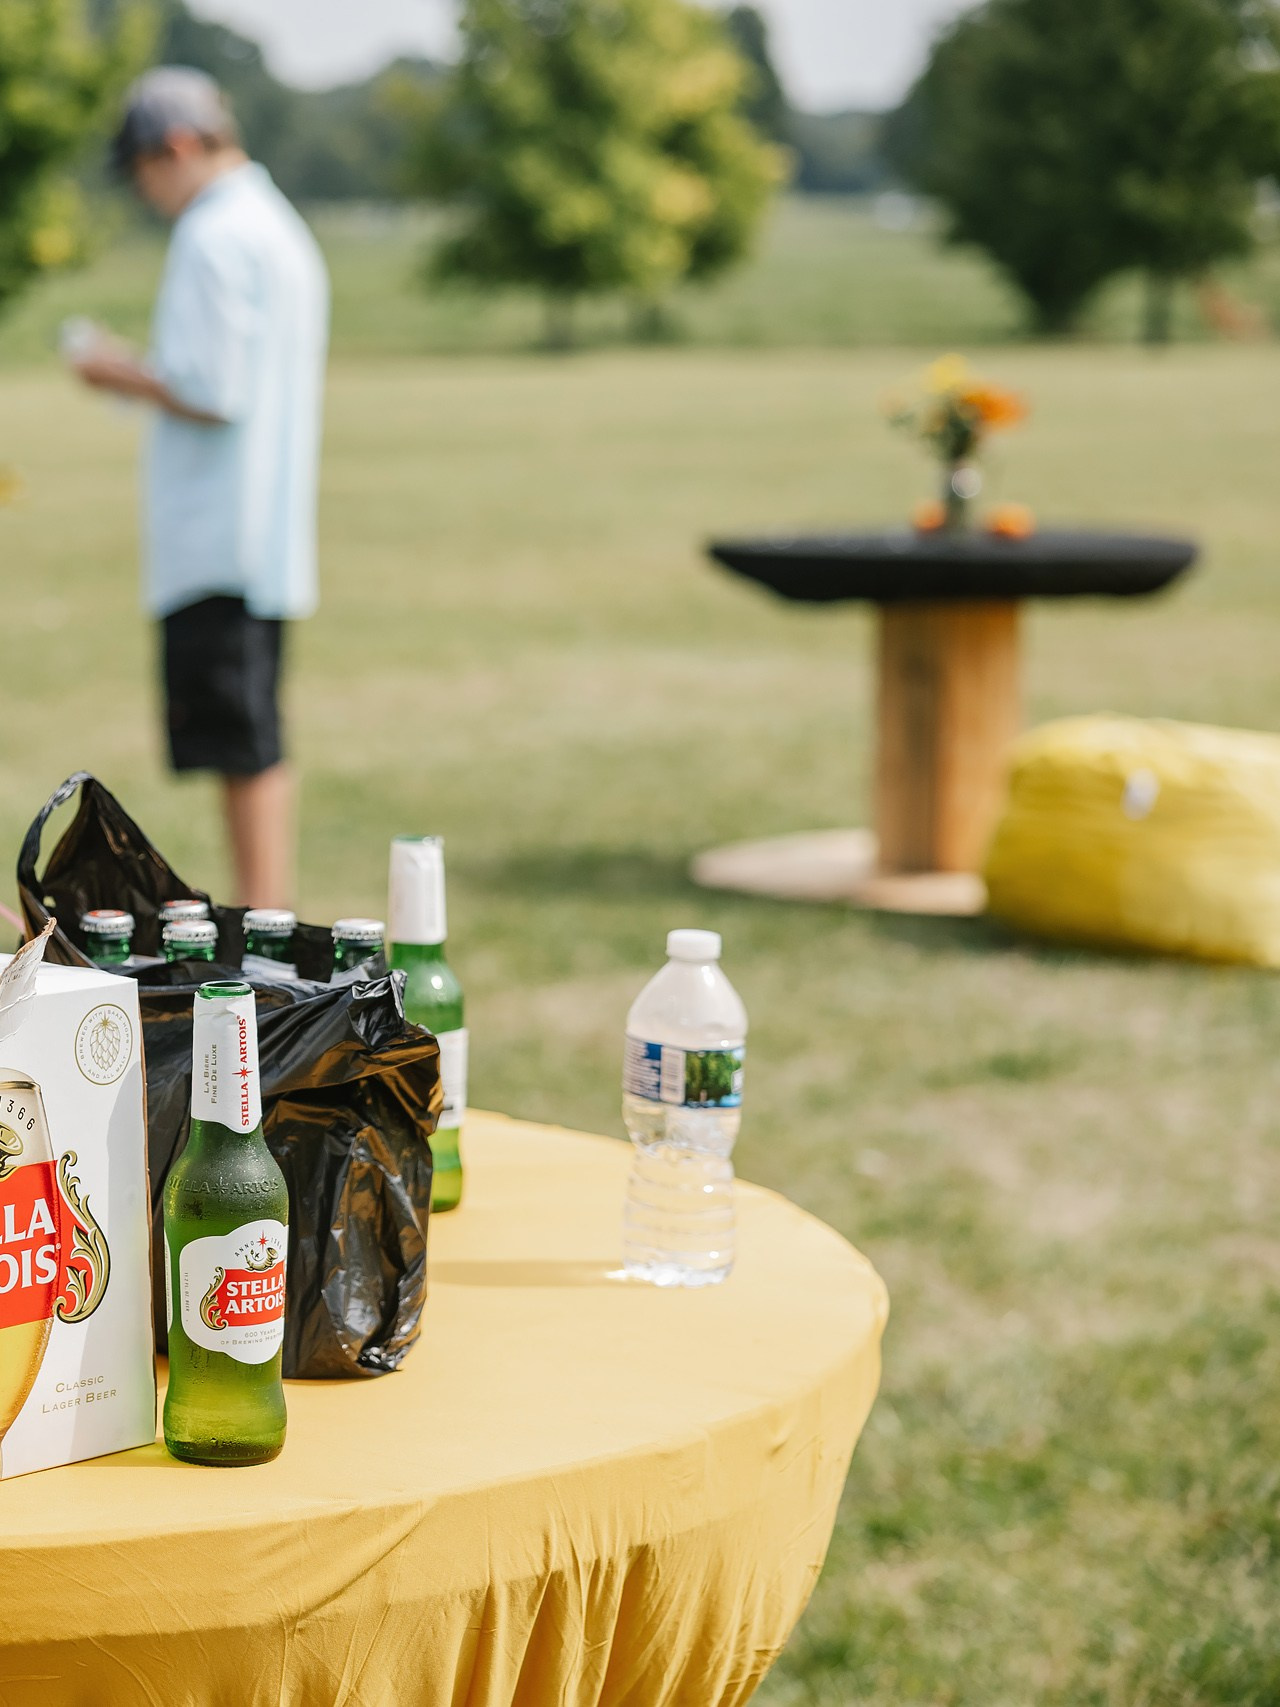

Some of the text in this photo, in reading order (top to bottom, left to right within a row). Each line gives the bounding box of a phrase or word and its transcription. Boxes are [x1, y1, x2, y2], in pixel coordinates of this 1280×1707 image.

[238, 1018, 250, 1126] STELLA ARTOIS
[234, 1240, 255, 1257] ANNO
[226, 1273, 284, 1297] STELLA
[224, 1290, 284, 1315] ARTOIS
[55, 1375, 105, 1393] CLASSIC
[42, 1389, 117, 1414] LAGER BEER
